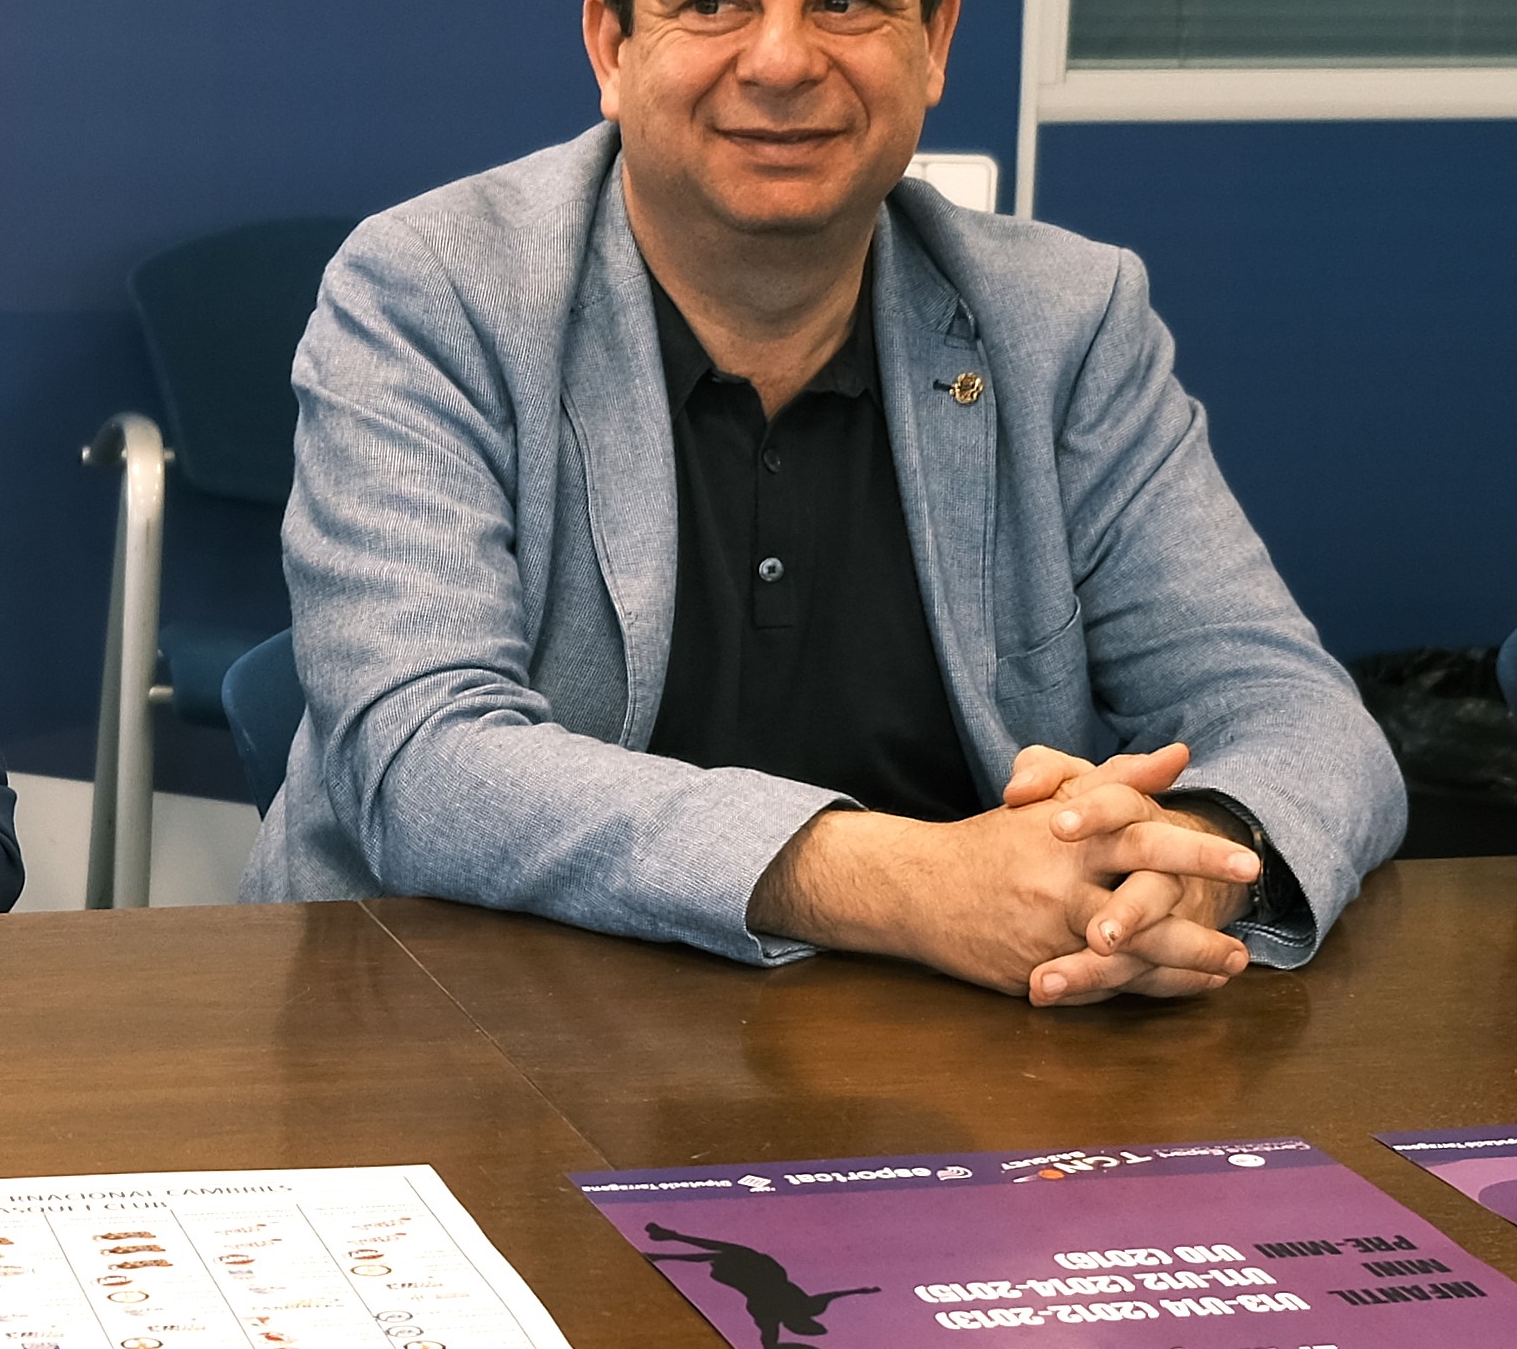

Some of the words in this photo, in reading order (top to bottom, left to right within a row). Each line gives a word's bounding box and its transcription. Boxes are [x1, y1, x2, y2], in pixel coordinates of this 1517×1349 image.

[1053, 1149, 1153, 1174] TGN
[165, 1182, 294, 1197] CAMBRILS
[782, 1166, 932, 1186] esportcat
[99, 1201, 172, 1213] CLUB
[1052, 1245, 1171, 1273] (2016)
[1171, 1243, 1246, 1267] U10
[1253, 1233, 1419, 1262] PRE-MINI
[1134, 1265, 1277, 1293] U11-U12
[1359, 1256, 1453, 1281] MINI
[913, 1272, 1133, 1304] (2014-2015)
[1326, 1279, 1488, 1307] INFANTIL
[933, 1299, 1160, 1331] (2012-2013)
[1160, 1291, 1311, 1321] U13-U14
